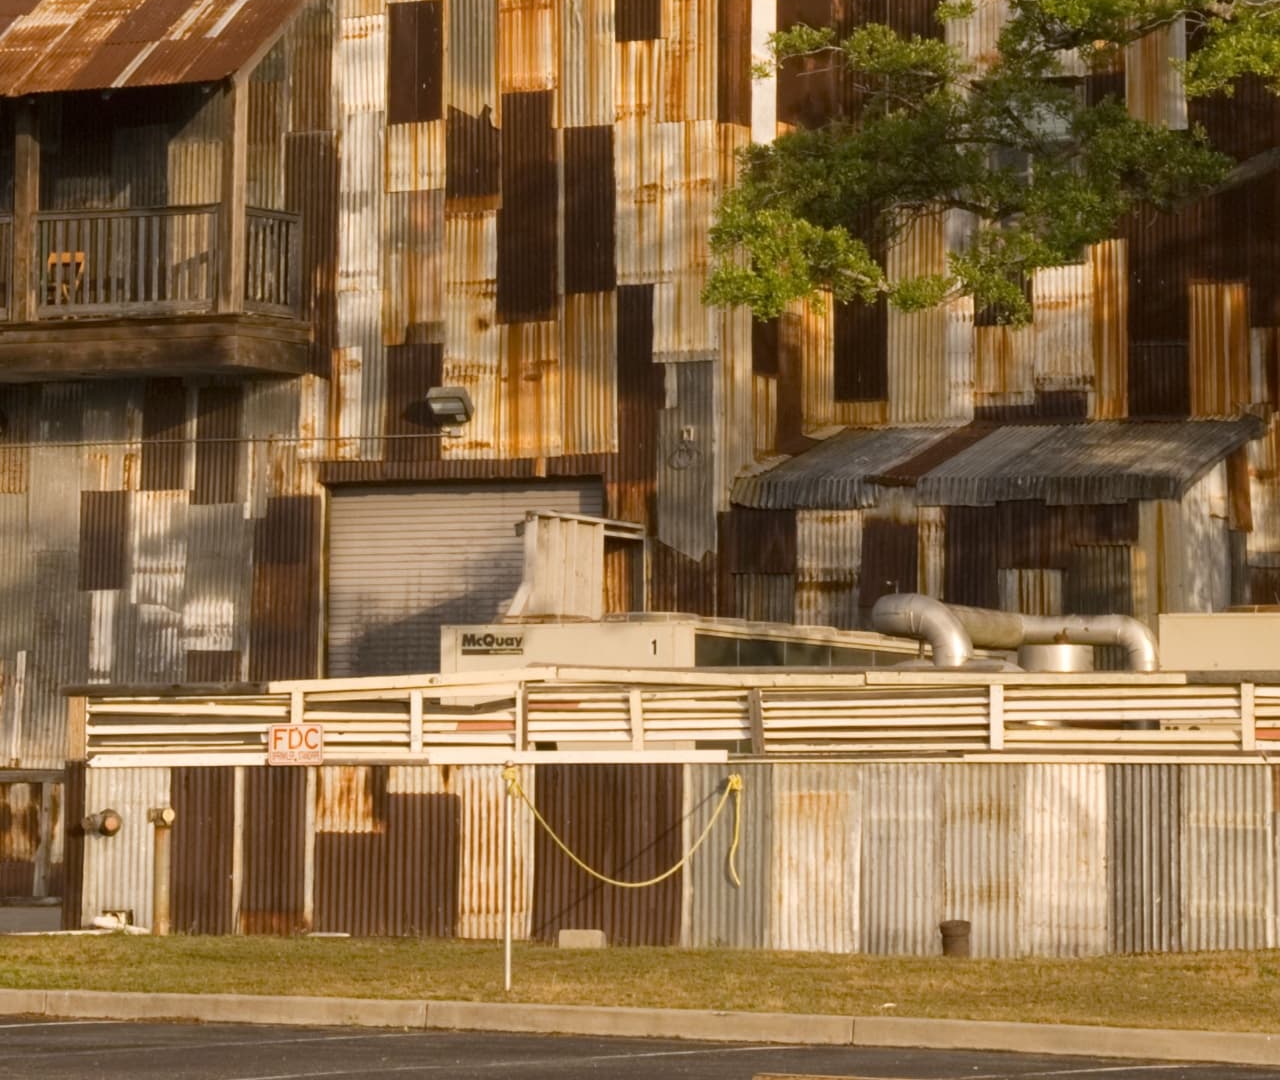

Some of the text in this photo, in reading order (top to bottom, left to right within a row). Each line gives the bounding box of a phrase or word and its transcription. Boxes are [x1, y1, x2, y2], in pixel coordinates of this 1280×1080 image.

[461, 633, 523, 647] McQuay
[650, 638, 658, 656] 1
[272, 728, 320, 750] FDC
